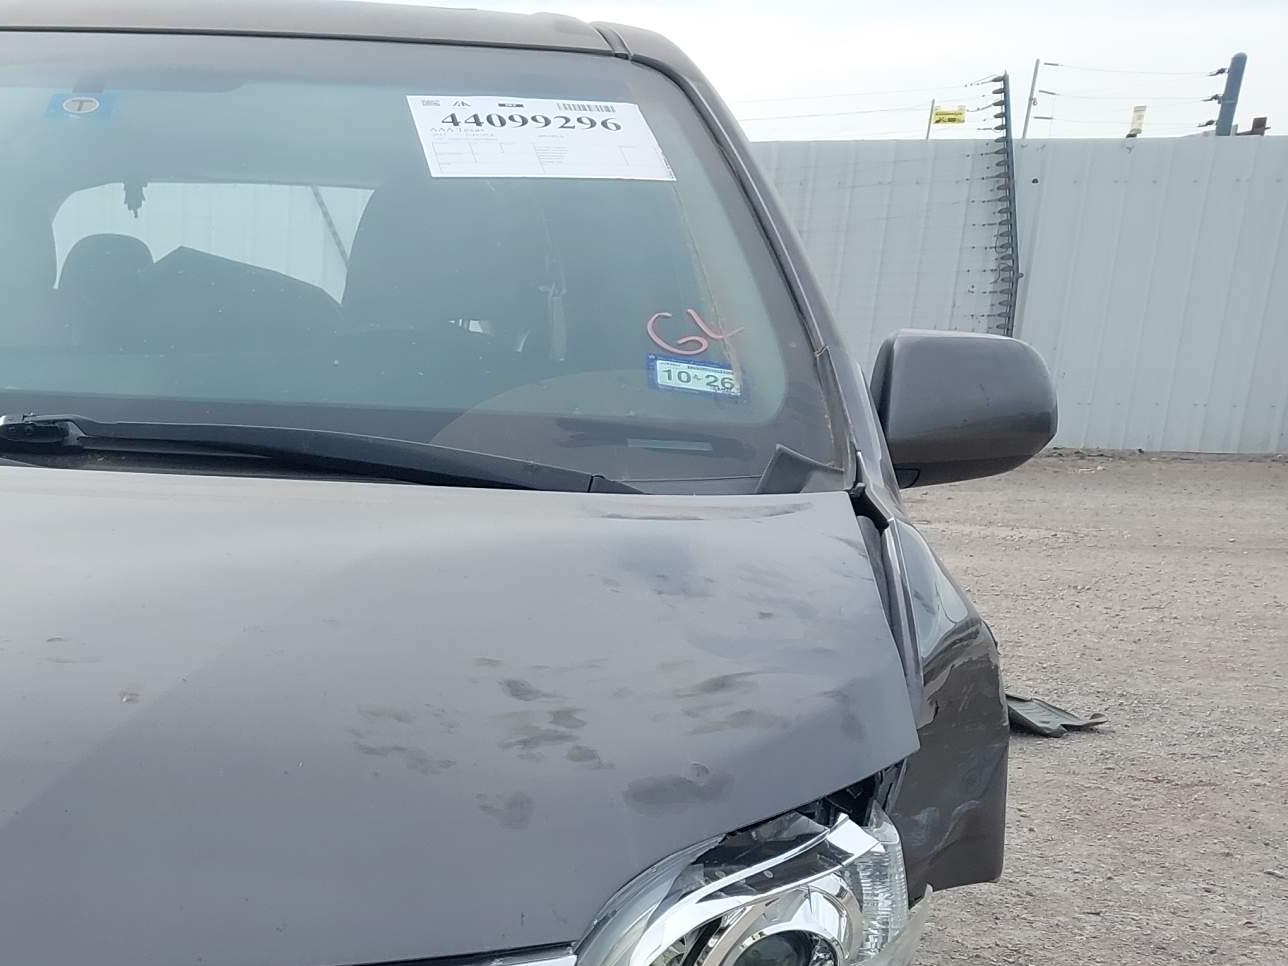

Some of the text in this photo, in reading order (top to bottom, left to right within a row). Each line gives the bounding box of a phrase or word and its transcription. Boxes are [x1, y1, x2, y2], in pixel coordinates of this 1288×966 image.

[441, 113, 622, 131] 44099296
[663, 369, 692, 384] 10
[704, 374, 736, 391] 26
